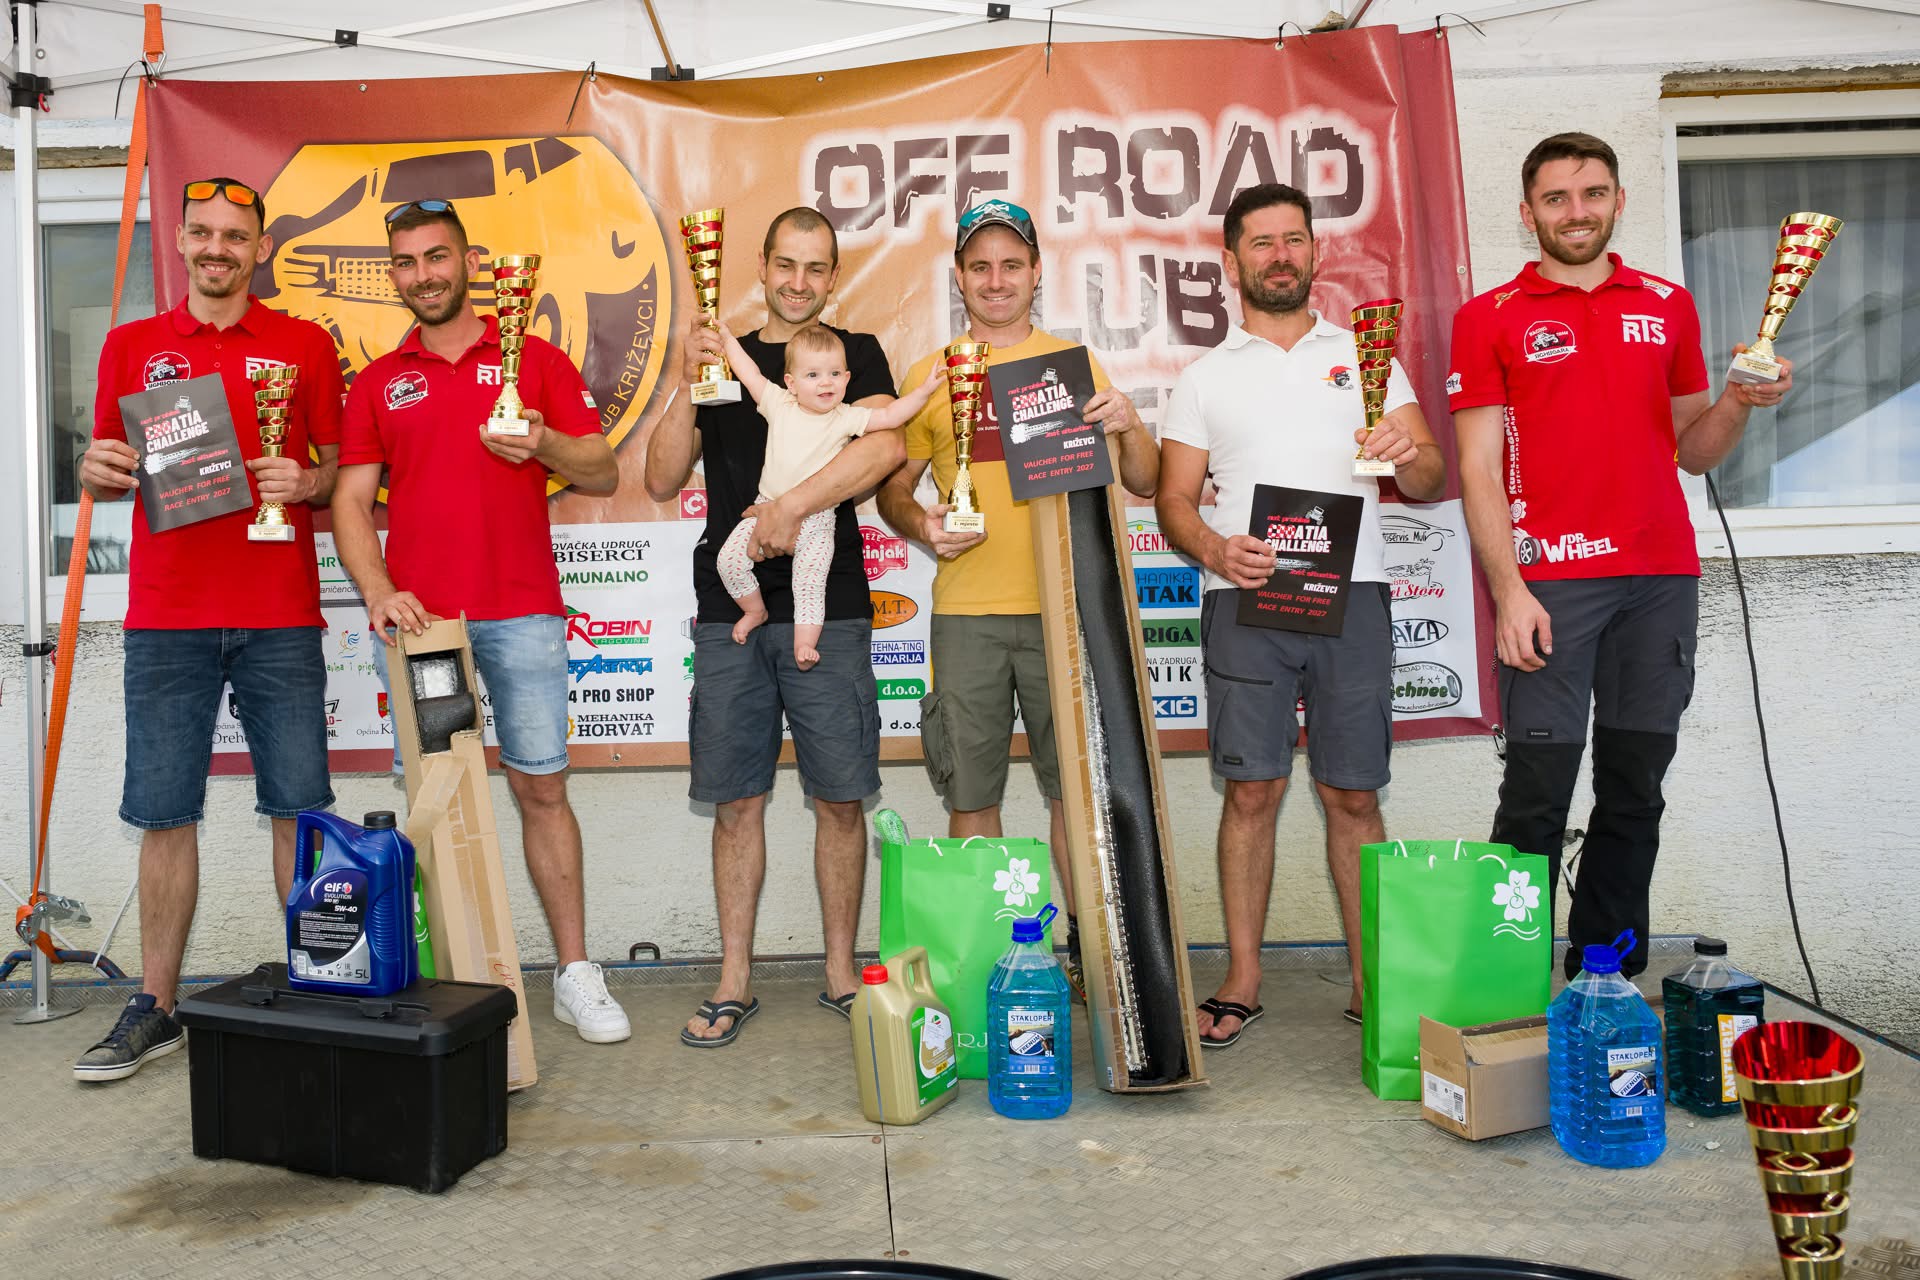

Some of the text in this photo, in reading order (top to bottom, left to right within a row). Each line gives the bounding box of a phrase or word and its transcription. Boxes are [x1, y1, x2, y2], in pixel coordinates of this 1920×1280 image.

[814, 120, 1364, 233] OFF ROAD
[1621, 313, 1666, 345] RTS
[246, 356, 297, 379] RT
[600, 299, 654, 432] UB KRIŽEVCI
[477, 363, 504, 385] RT
[1012, 383, 1068, 411] CROATIA
[1012, 396, 1075, 423] CHALLENGE
[144, 410, 203, 441] CROATIA
[146, 422, 210, 453] CHALLENGE
[1063, 436, 1095, 449] KRIŽEVCI
[1023, 450, 1094, 469] VAUCHER FOR FREE
[200, 460, 232, 476] KRIŽEVCI
[1028, 463, 1094, 481] RACE ENTRY 2027
[159, 474, 231, 500] VAUCHER FOR FREE
[164, 487, 231, 512] RACE ENTRY 2027
[1267, 523, 1328, 540] CROATIA
[1567, 532, 1587, 544] DR.
[601, 540, 651, 549] UDRUGA
[1264, 538, 1332, 553] CHALLENGE
[1541, 534, 1619, 563] WHEEL
[553, 549, 645, 563] BISERCI
[863, 545, 905, 562] injak
[1303, 582, 1338, 594] KRIŽEVCI
[1389, 577, 1410, 586] istro
[1257, 590, 1331, 606] VAUCHER FOR FREE
[1404, 584, 1445, 598] Story
[1257, 602, 1328, 617] RACE ENTRY 2027
[567, 613, 652, 649] ROBIN
[1143, 626, 1195, 643] RIGA
[1160, 657, 1198, 665] ZADRUGA
[583, 689, 611, 703] PRO
[616, 688, 655, 702] SHOP
[882, 683, 921, 696] d.o.o.
[577, 713, 654, 722] MEHANIKA
[215, 722, 235, 732] pčina
[577, 723, 654, 737] HORVAT
[324, 883, 342, 893] elf
[334, 904, 358, 913] 5W-40
[355, 969, 369, 979] 5L
[1019, 1035, 1041, 1054] FRENUM
[1610, 1051, 1653, 1061] STAKLOPER
[1620, 1073, 1642, 1096] FRENUM
